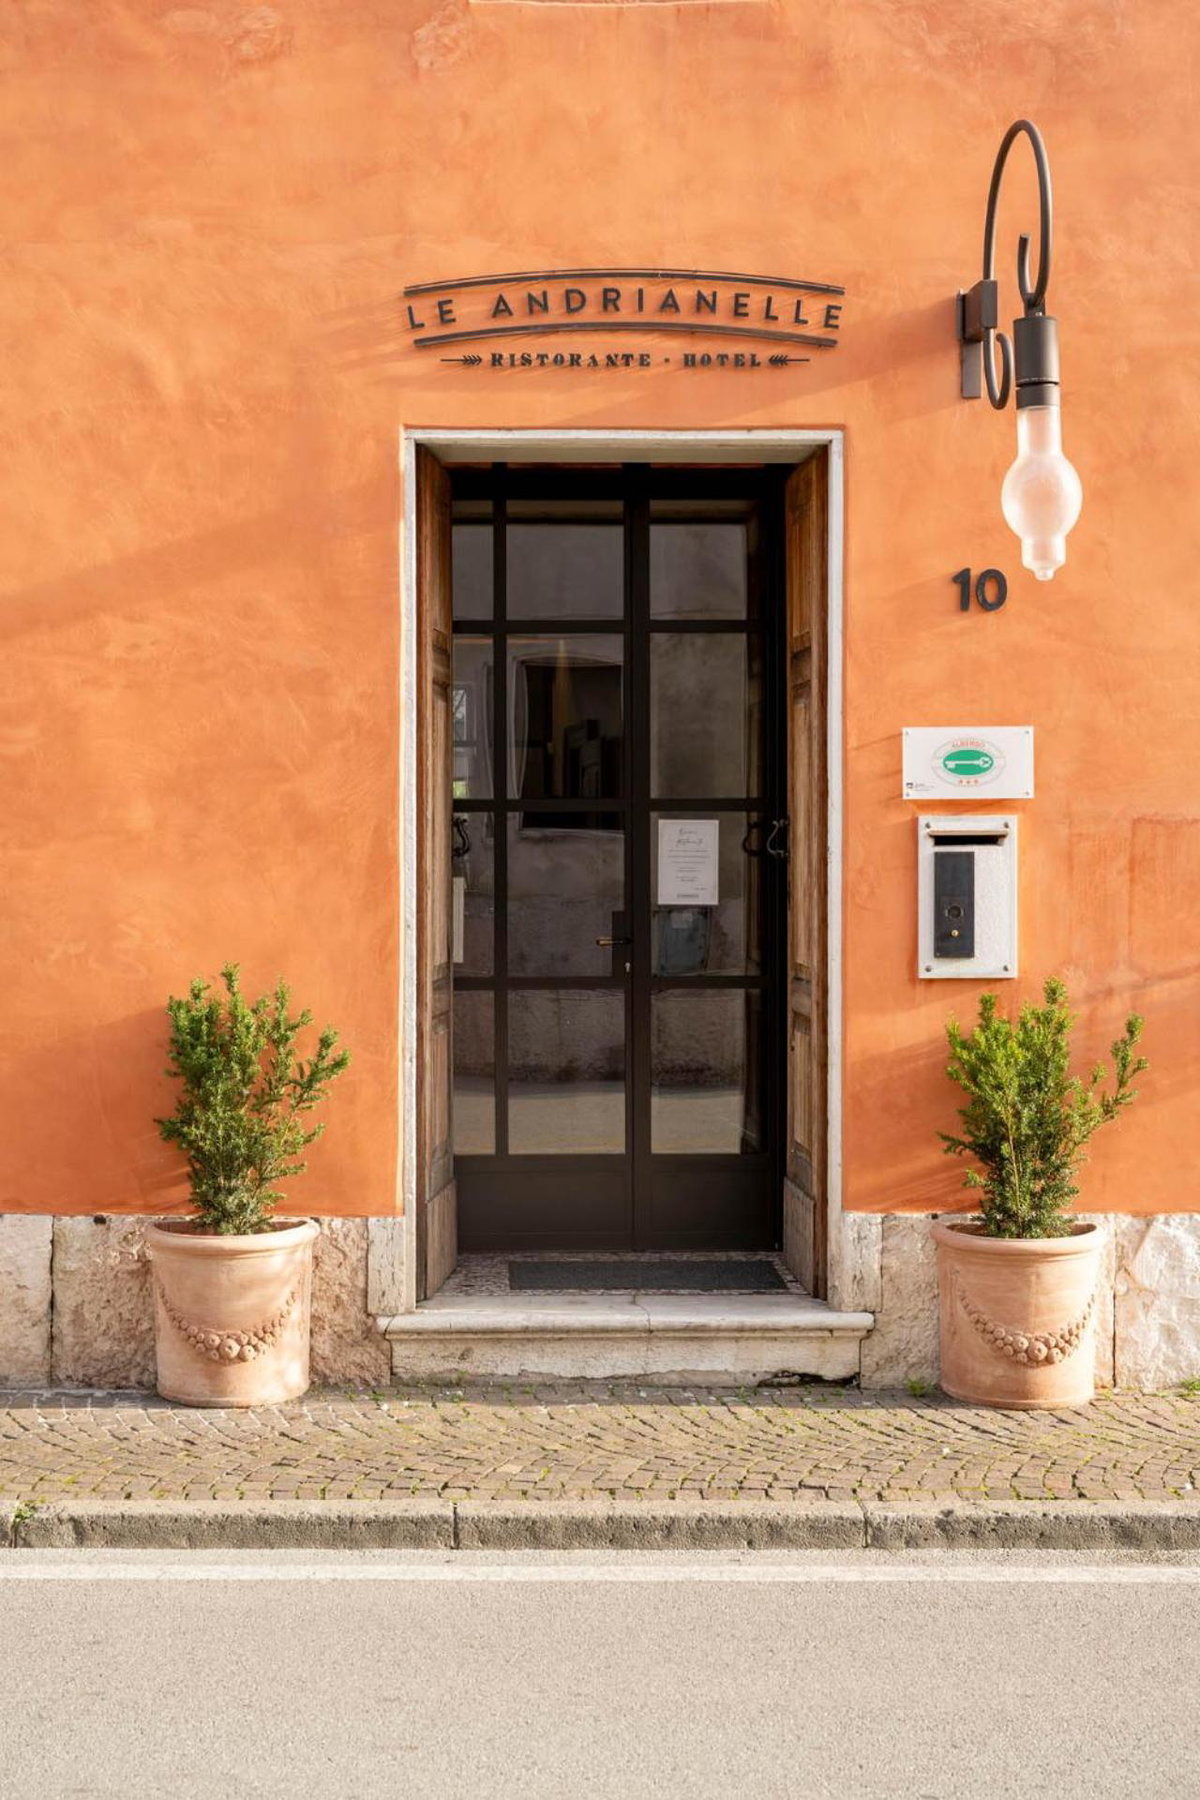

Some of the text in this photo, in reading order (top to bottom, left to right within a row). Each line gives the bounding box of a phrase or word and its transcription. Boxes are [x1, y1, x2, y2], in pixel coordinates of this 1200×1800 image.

[407, 286, 843, 330] LE ANDRIANELLE
[490, 352, 761, 368] RISTORANTE HOTEL
[951, 567, 1008, 613] 10
